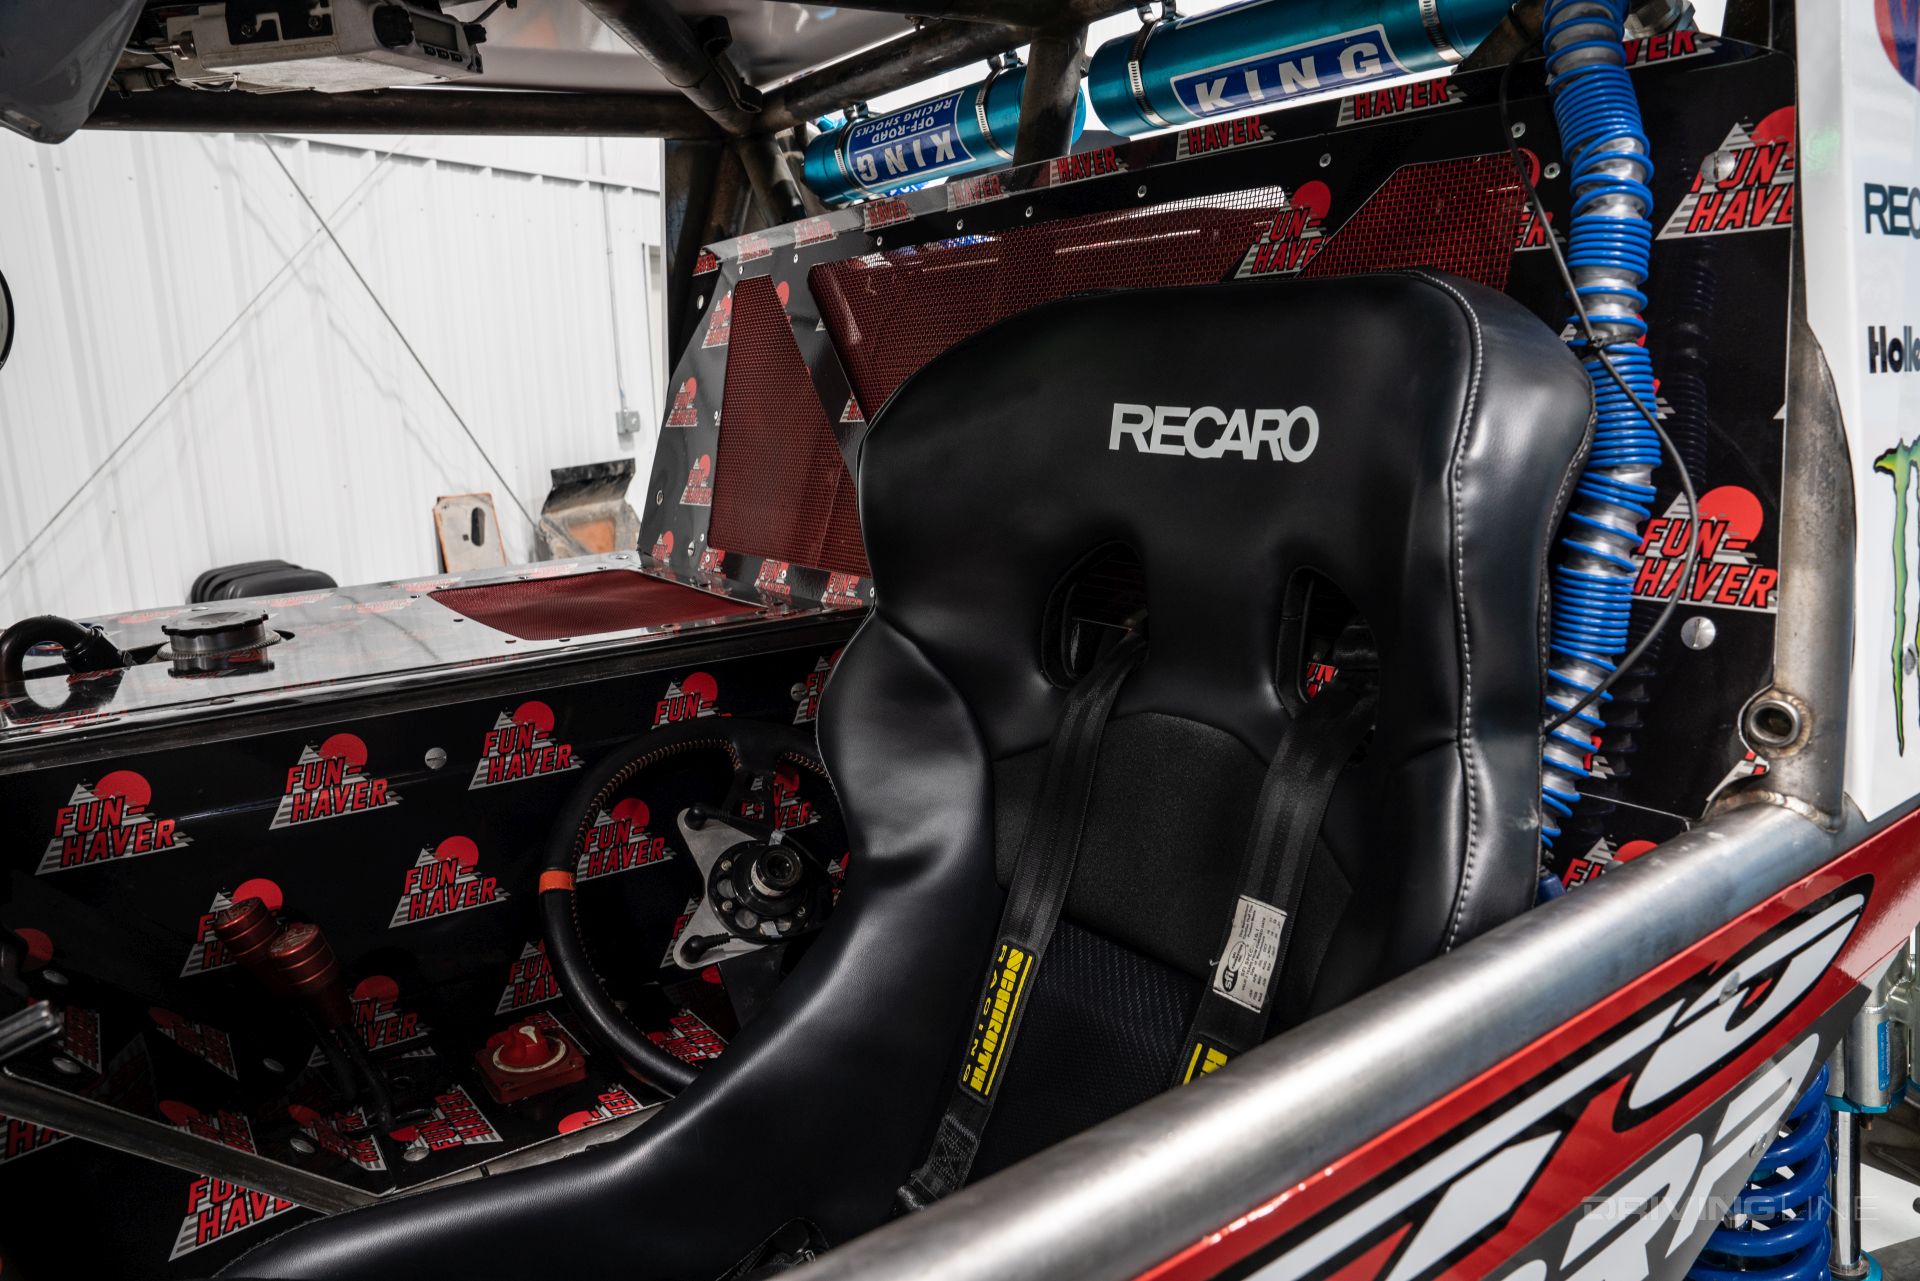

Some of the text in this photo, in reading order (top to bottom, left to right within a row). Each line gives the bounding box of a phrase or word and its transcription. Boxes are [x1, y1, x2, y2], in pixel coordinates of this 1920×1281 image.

[1194, 42, 1384, 112] KING
[1354, 76, 1449, 121] HAVER
[855, 99, 952, 138] RACING SHOCKS
[871, 116, 935, 144] OFF-ROAD
[1186, 115, 1264, 155] HAVER
[856, 130, 956, 182] KING
[1057, 145, 1118, 184] HAVER
[1689, 142, 1794, 192] UN-
[1109, 402, 1319, 463] RECARO
[1637, 517, 1750, 561] FUN-
[1633, 557, 1778, 609] HAVER
[653, 694, 715, 726] FUN-
[481, 721, 551, 759] FUN-
[284, 757, 364, 795] FUN-
[485, 743, 573, 785] HAVER
[54, 795, 147, 838] FUN-
[289, 777, 389, 824] HAVER
[59, 818, 176, 868] HAVER
[582, 818, 646, 854] FUN-
[586, 836, 666, 878] HAVER
[402, 857, 476, 896] FUN-
[407, 877, 498, 922] HAVER
[970, 948, 1024, 1092] SCHROTH
